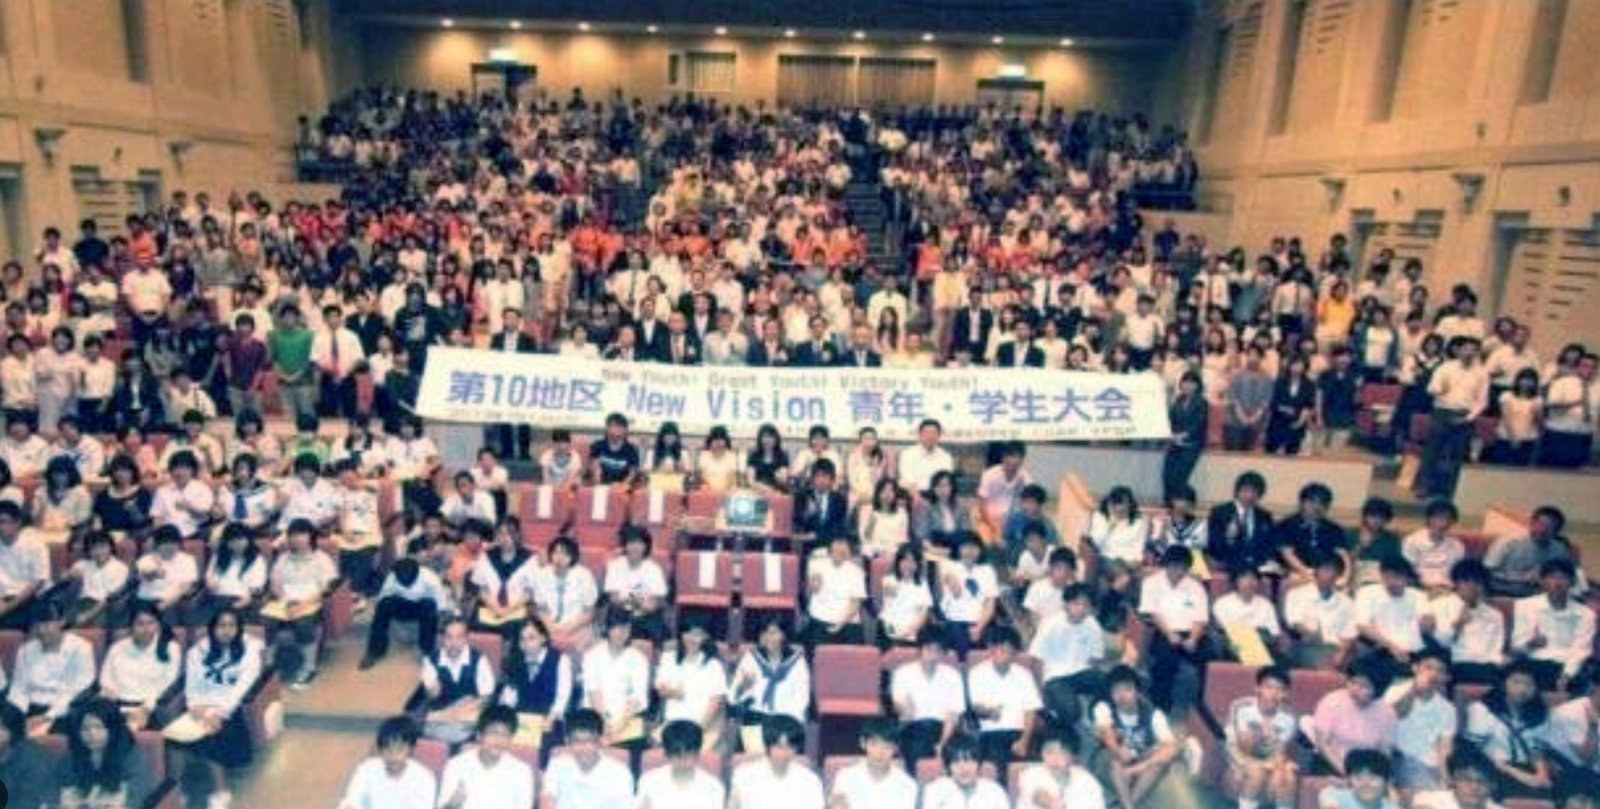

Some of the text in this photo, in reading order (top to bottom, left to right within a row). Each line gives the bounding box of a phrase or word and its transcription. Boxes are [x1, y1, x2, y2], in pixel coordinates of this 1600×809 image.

[447, 371, 1131, 424] 第10地区 New Vision 青年・学生大会
